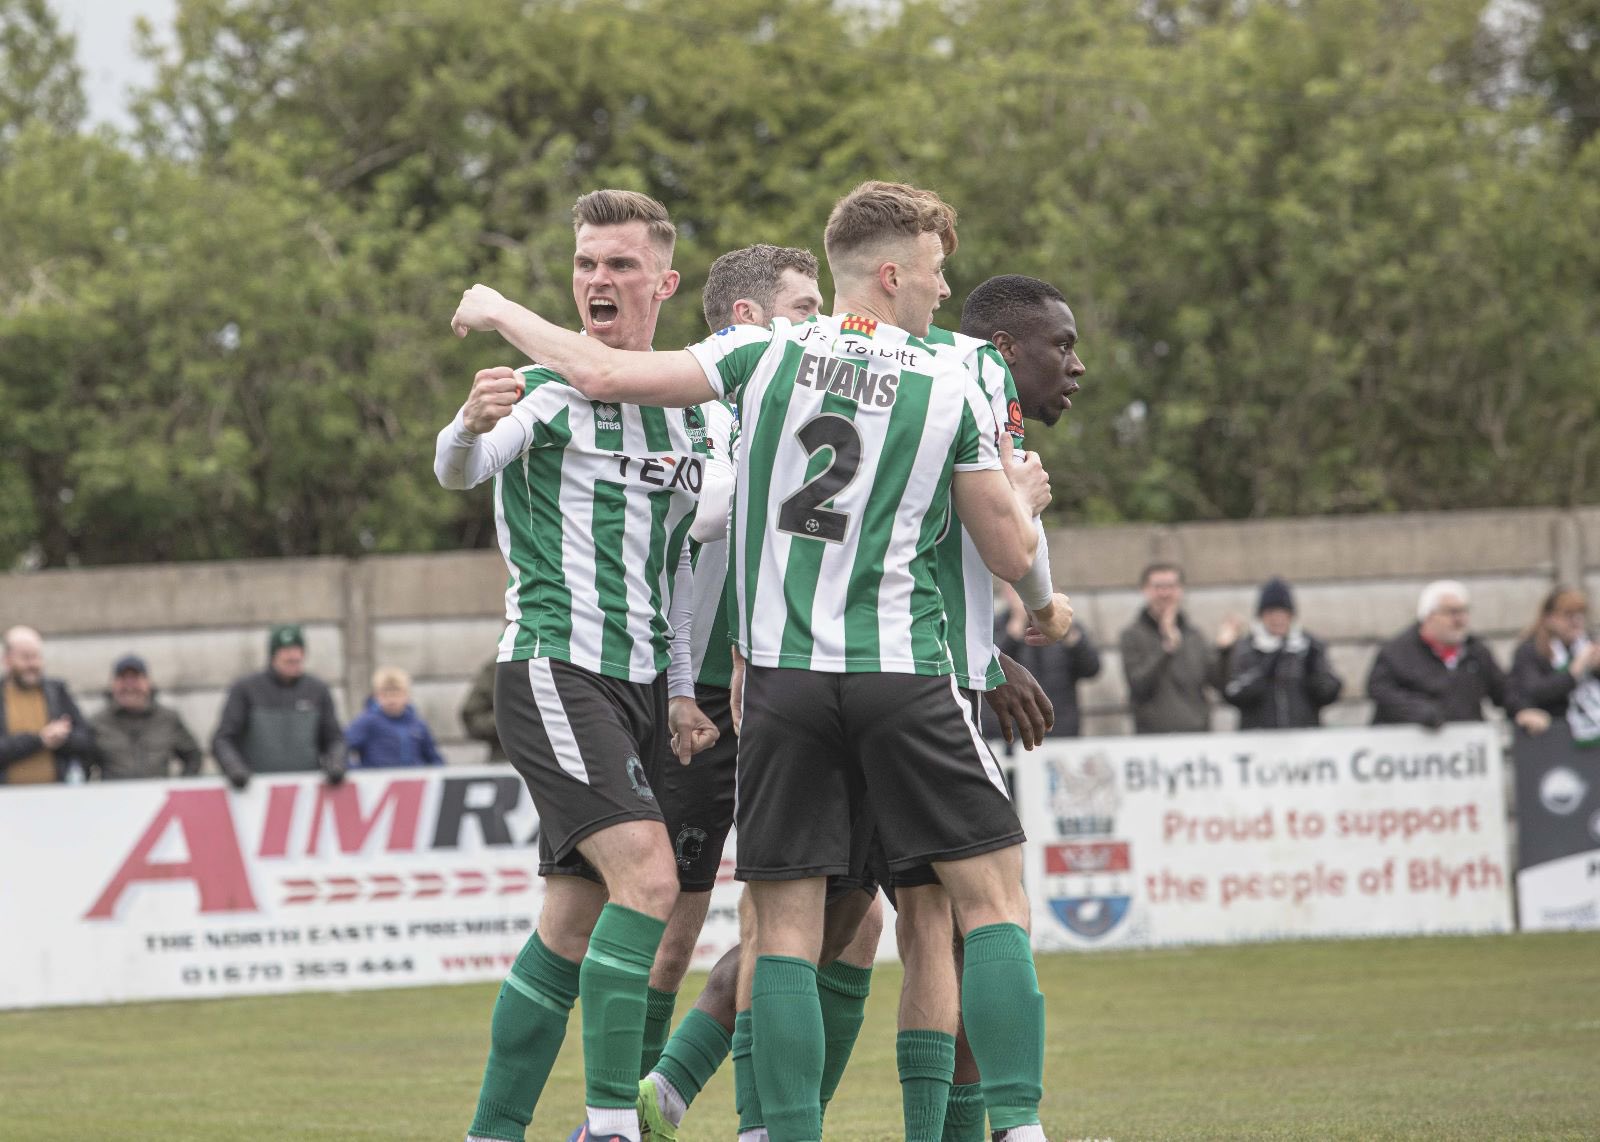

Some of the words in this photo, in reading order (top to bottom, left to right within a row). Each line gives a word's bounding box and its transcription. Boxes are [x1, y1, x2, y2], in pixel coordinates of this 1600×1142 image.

[794, 352, 899, 408] EVANS
[613, 453, 701, 495] TEXO
[776, 411, 865, 545] 2
[1125, 756, 1223, 798] Blyth
[1233, 752, 1339, 787] Town
[1350, 744, 1487, 782] Council
[84, 777, 540, 919] AIMR
[1162, 806, 1275, 844] Proud
[1285, 809, 1326, 840] to
[1336, 801, 1481, 845] support
[1146, 868, 1207, 903] the
[1219, 861, 1347, 909] people
[1357, 855, 1395, 896] of
[1407, 854, 1504, 899] Blyth
[146, 933, 194, 952] THE
[205, 929, 299, 948] NORTH
[309, 924, 399, 943] EAST'S
[408, 917, 532, 936] PREMIER
[182, 963, 283, 984] 01670
